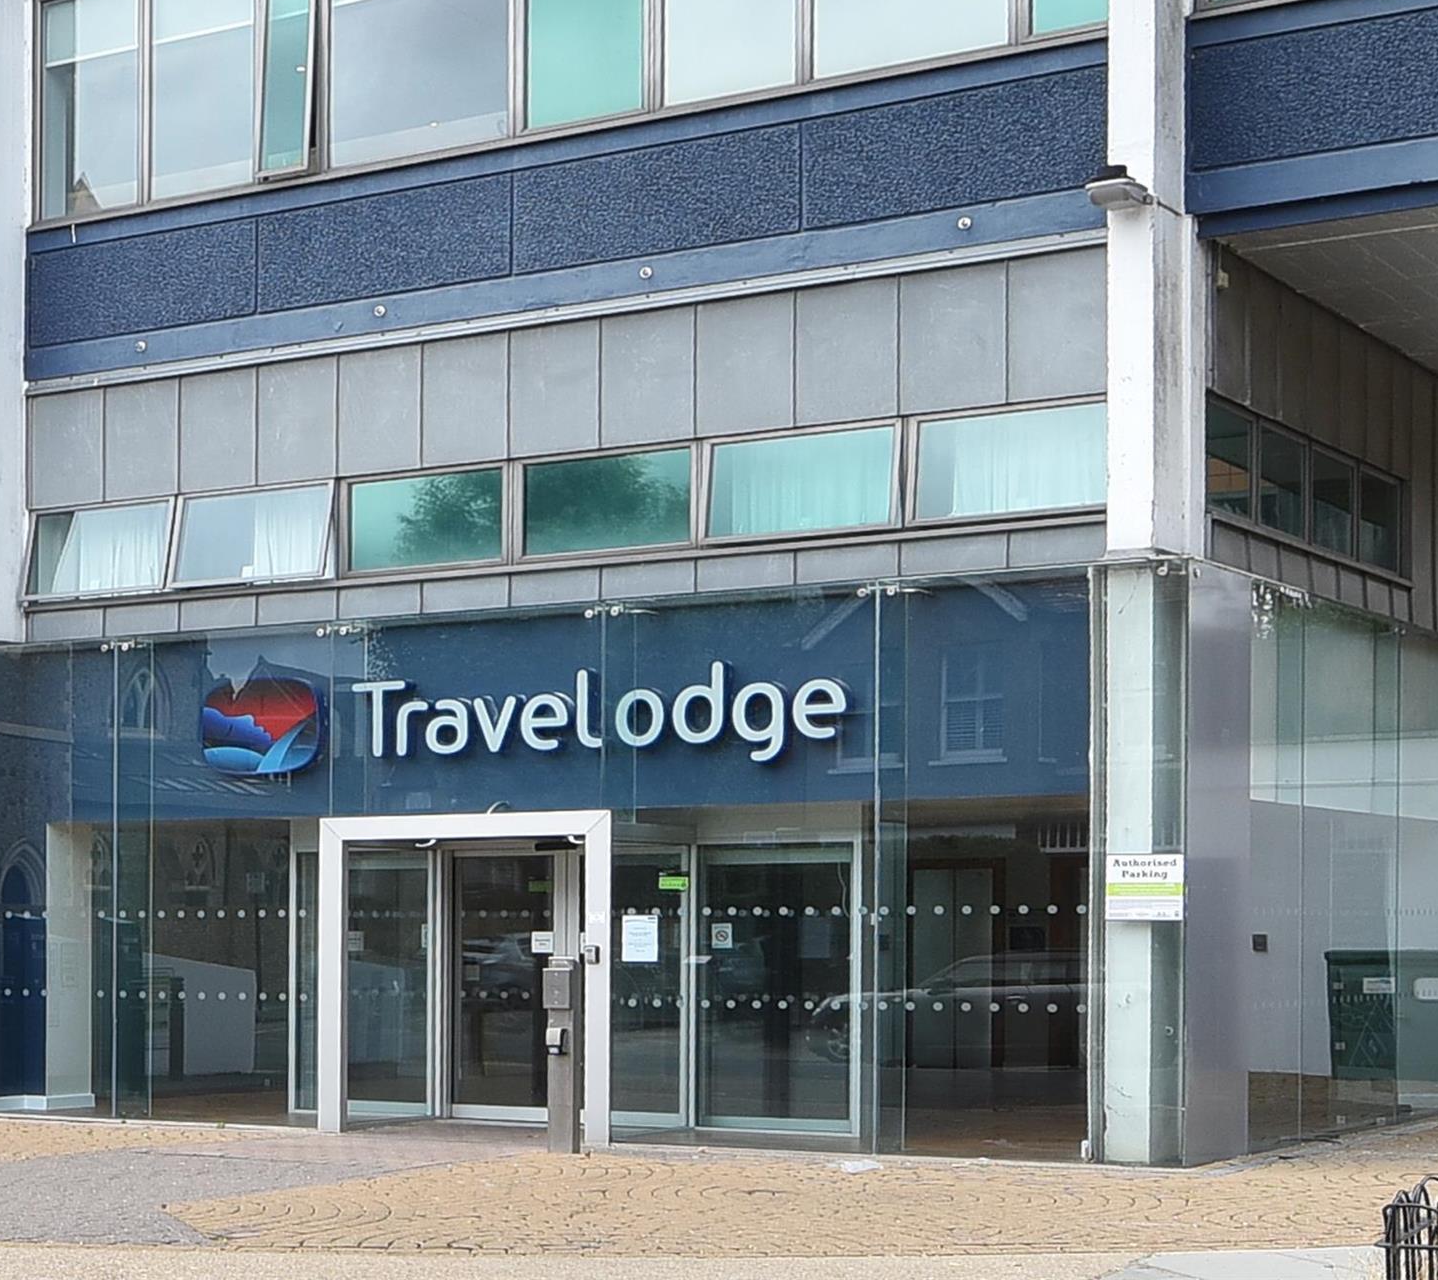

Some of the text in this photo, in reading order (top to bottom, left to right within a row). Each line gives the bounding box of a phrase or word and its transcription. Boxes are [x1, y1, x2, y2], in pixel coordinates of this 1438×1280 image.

[351, 660, 847, 762] Travelodge
[1113, 858, 1177, 868] Authorised
[1122, 870, 1168, 880] Parking
